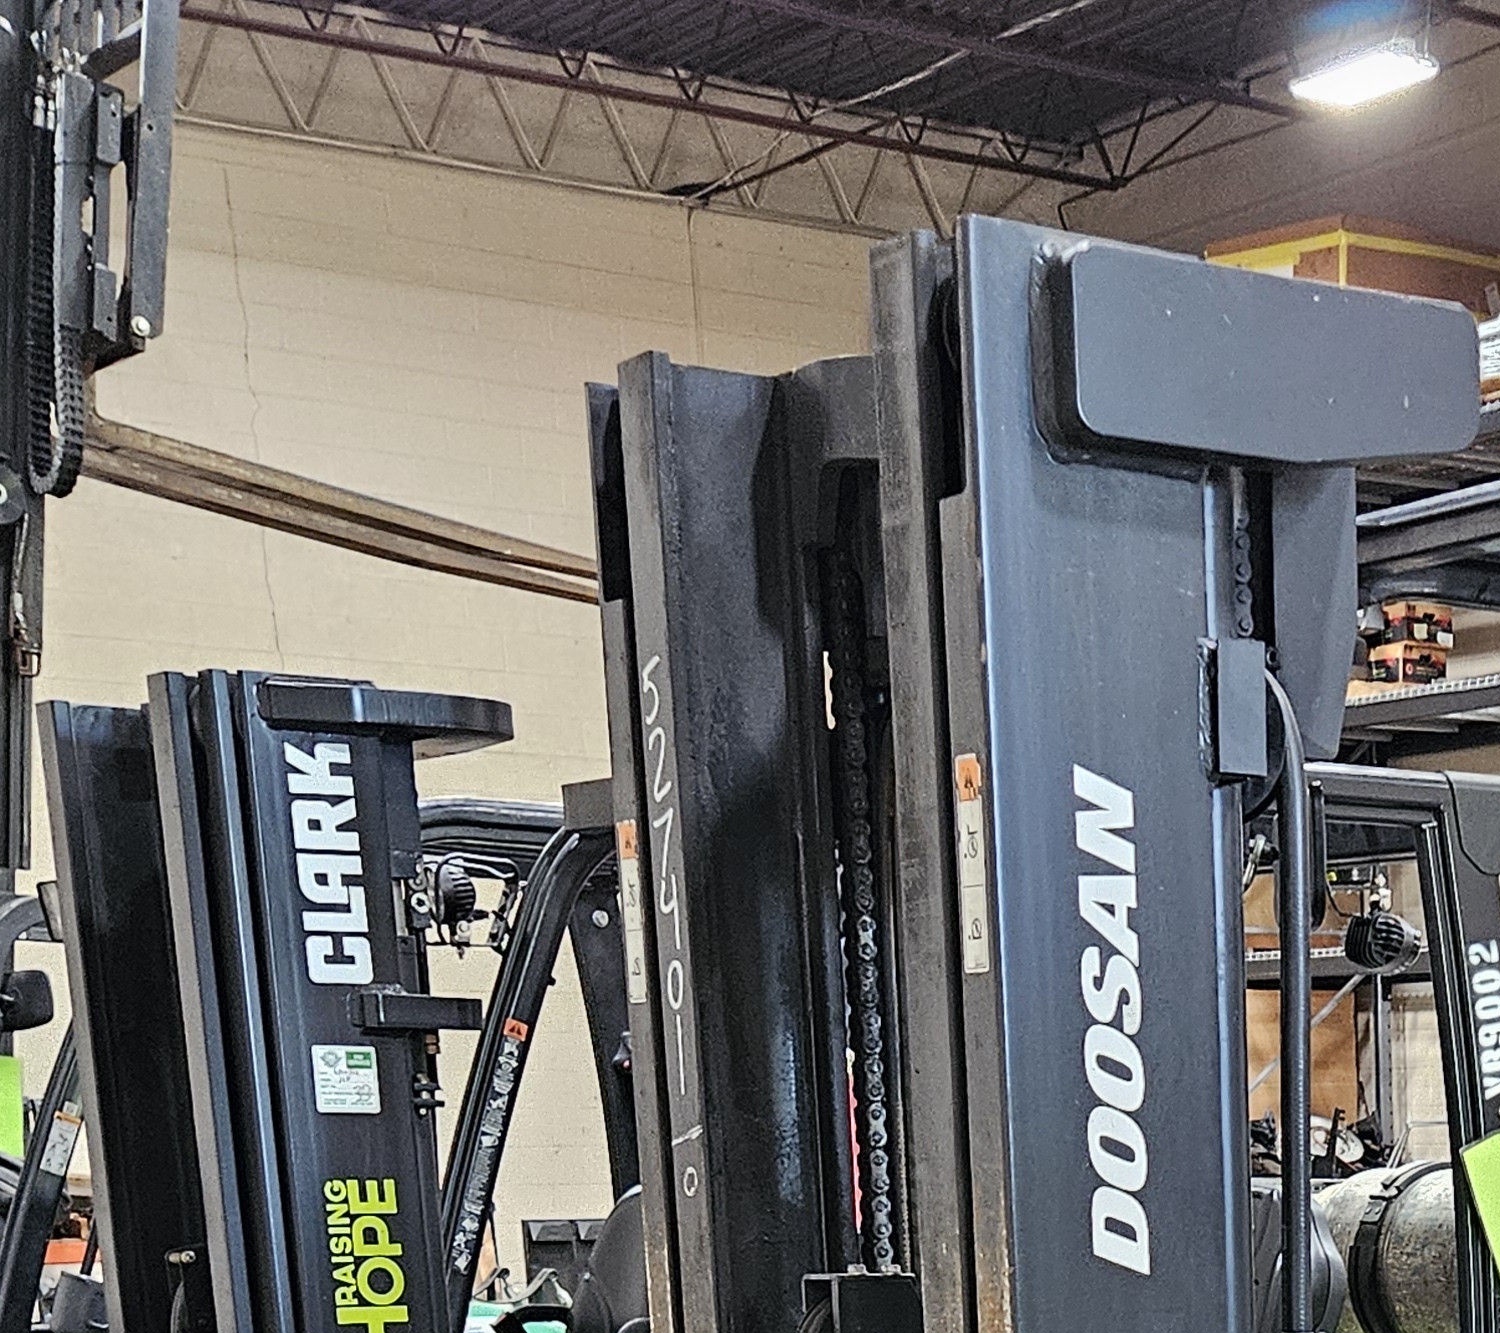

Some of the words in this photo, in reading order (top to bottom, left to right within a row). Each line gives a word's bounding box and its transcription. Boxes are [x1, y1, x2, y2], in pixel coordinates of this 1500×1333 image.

[283, 741, 374, 985] CLARK
[1073, 763, 1151, 1276] DOOSAN
[324, 1179, 358, 1306] RAISING
